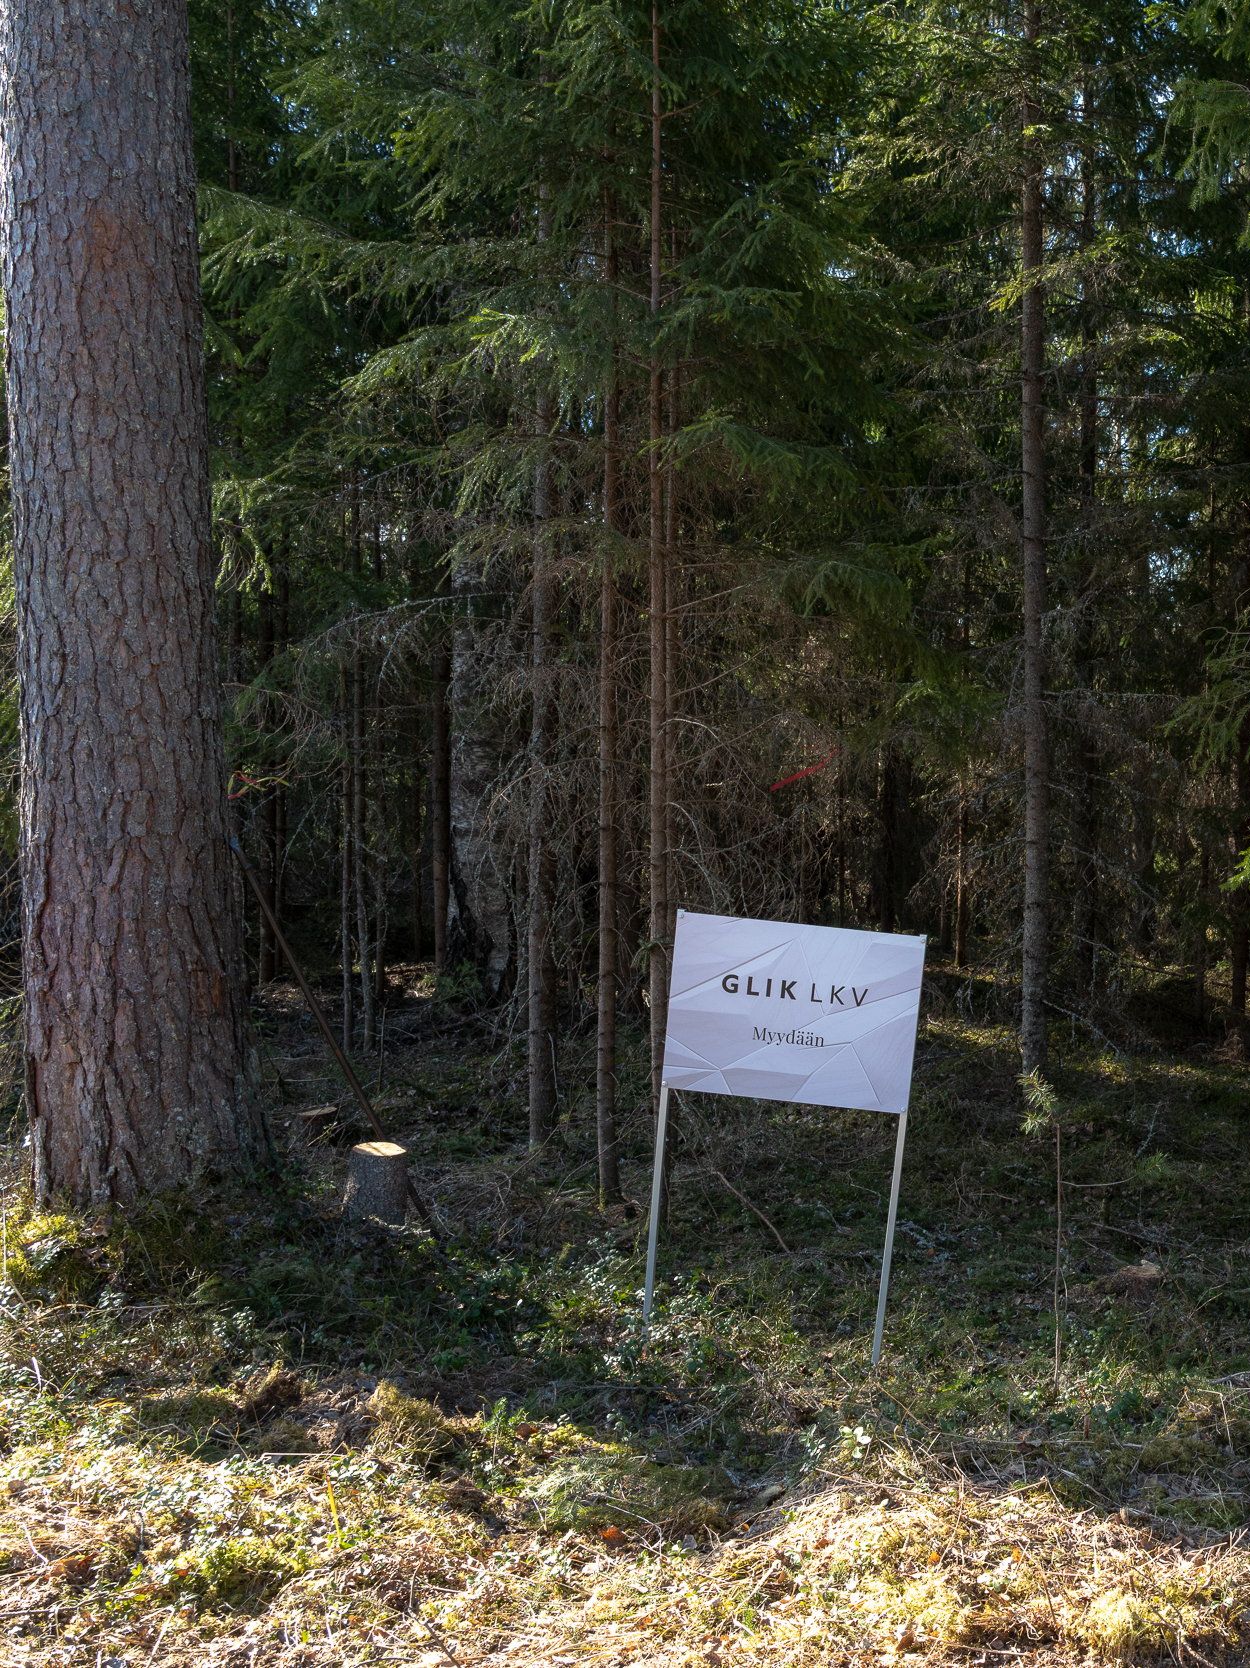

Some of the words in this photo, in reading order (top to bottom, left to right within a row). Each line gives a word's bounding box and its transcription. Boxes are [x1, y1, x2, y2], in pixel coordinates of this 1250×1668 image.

[721, 974, 798, 1001] GLIK
[810, 982, 869, 1007] LKV
[752, 1026, 825, 1048] Myydään
